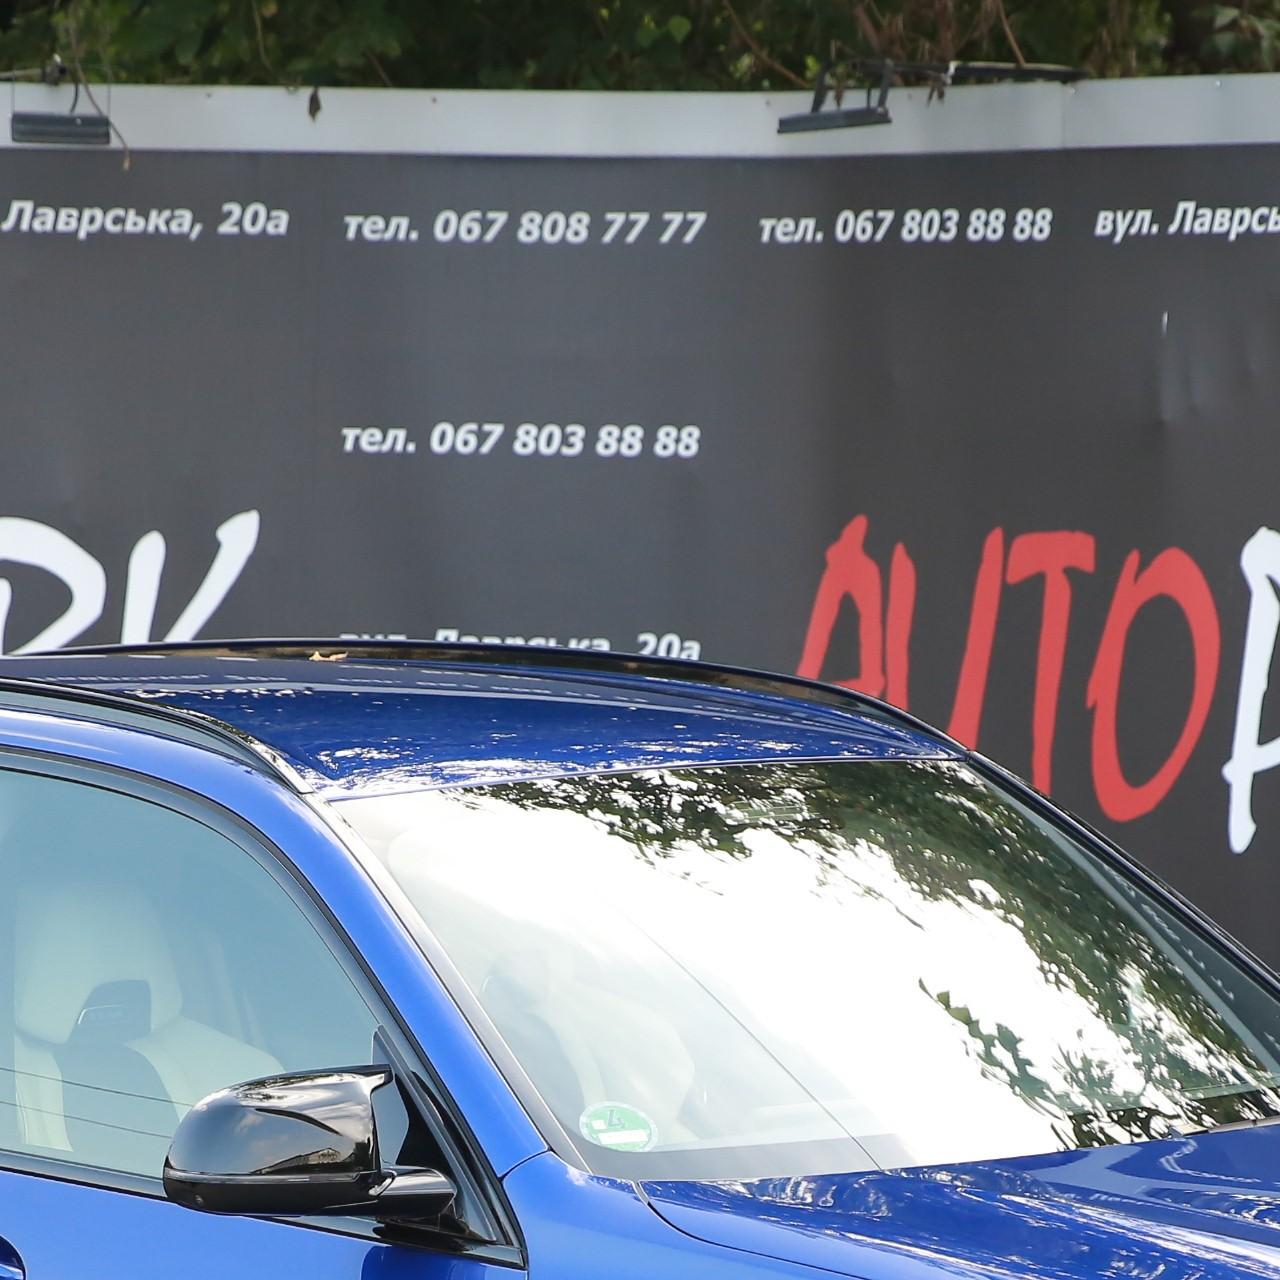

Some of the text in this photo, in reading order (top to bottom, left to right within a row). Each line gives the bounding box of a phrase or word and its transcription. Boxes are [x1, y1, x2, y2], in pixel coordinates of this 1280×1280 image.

[0, 199, 203, 241] Лаврська,
[217, 202, 290, 236] 20а
[343, 209, 708, 244] тел. 067 808 77 77
[759, 207, 1053, 244] тел. 067 803 88 88
[1094, 209, 1160, 244] вул.
[341, 421, 701, 458] тел. 067 803 88 88
